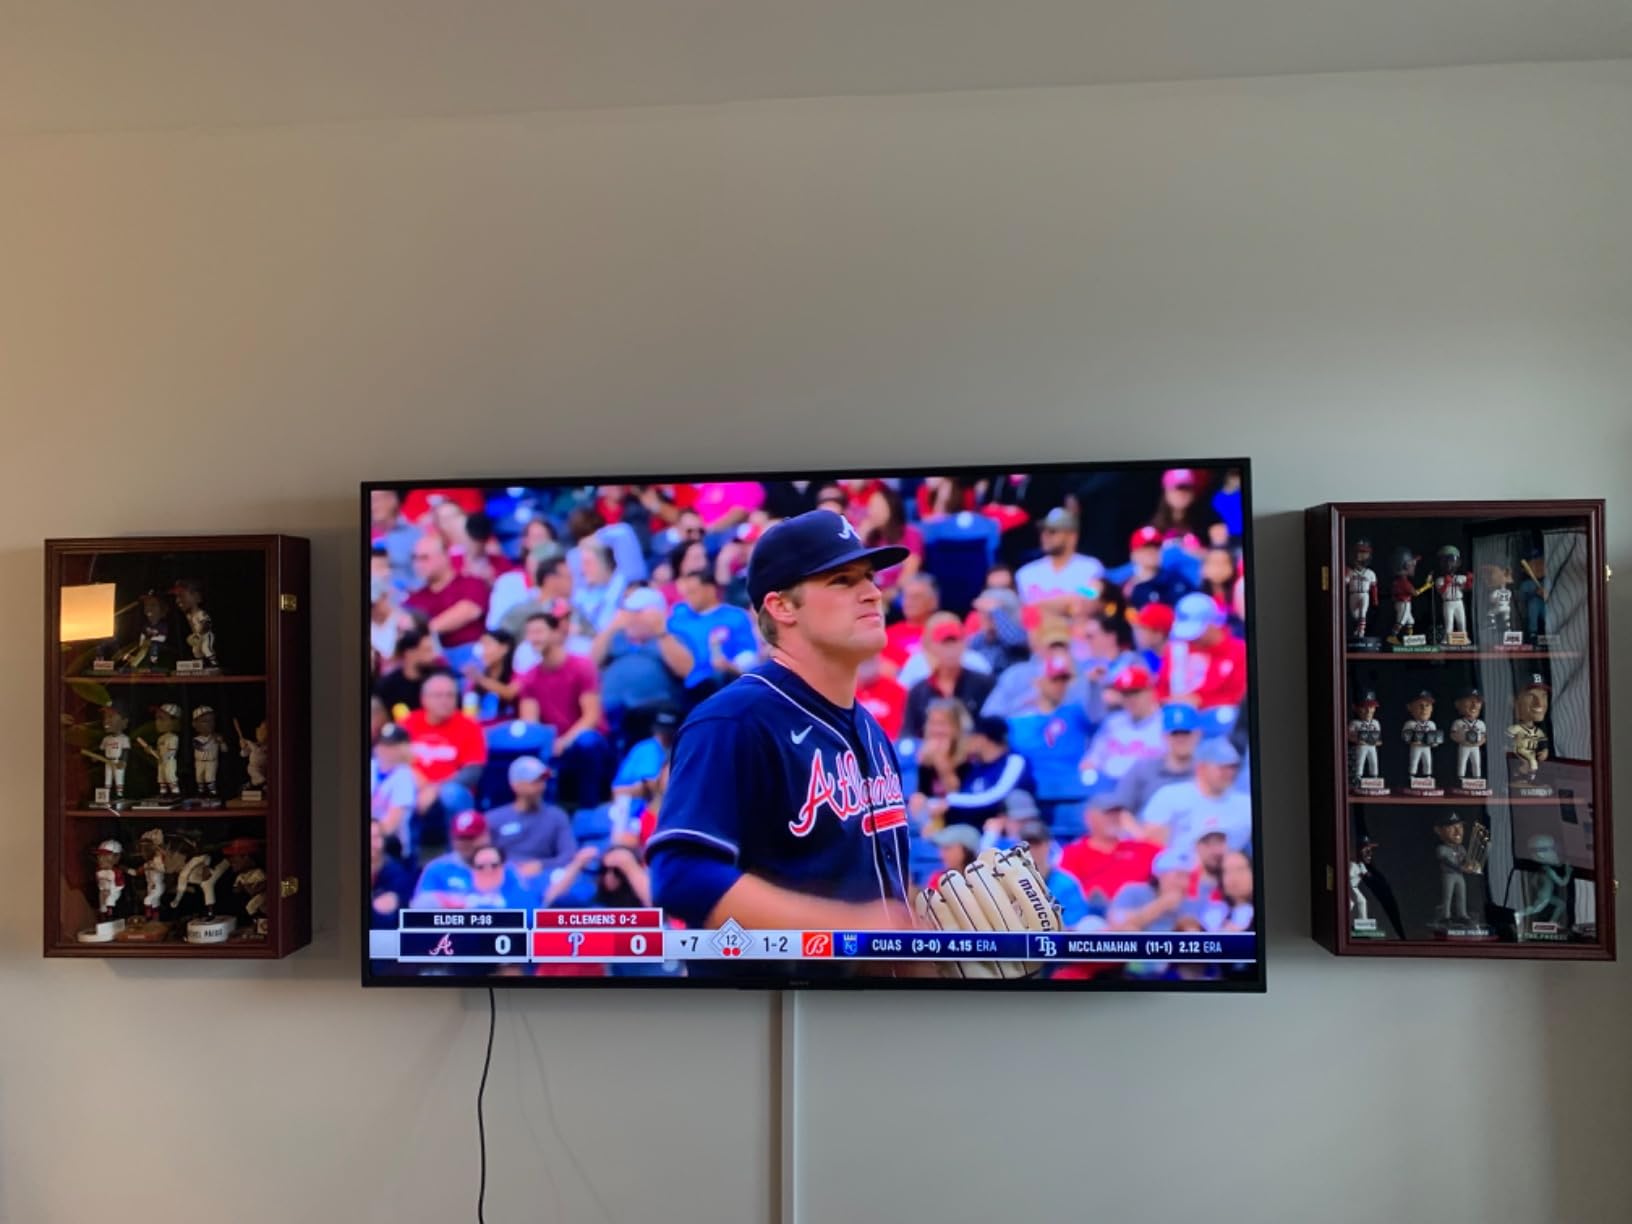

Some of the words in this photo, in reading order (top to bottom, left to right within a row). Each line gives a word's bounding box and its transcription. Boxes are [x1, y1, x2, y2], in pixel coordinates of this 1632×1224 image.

[433, 914, 465, 926] ELDER
[569, 914, 617, 925] CLEMENS
[619, 914, 638, 925] 0-2
[495, 935, 512, 955] 0
[630, 934, 648, 955] 0
[690, 936, 699, 952] 7
[726, 934, 738, 946] 12
[763, 936, 788, 952] 1-2
[872, 939, 902, 951] CUAS
[911, 938, 941, 953] (3-0)
[947, 939, 973, 952] 4.15
[976, 940, 997, 952] ERA
[1068, 940, 1138, 953] MCCLANAHAN
[1145, 940, 1173, 955] (11-1)
[1178, 941, 1200, 953] 2.12
[1203, 941, 1222, 953] ERA
